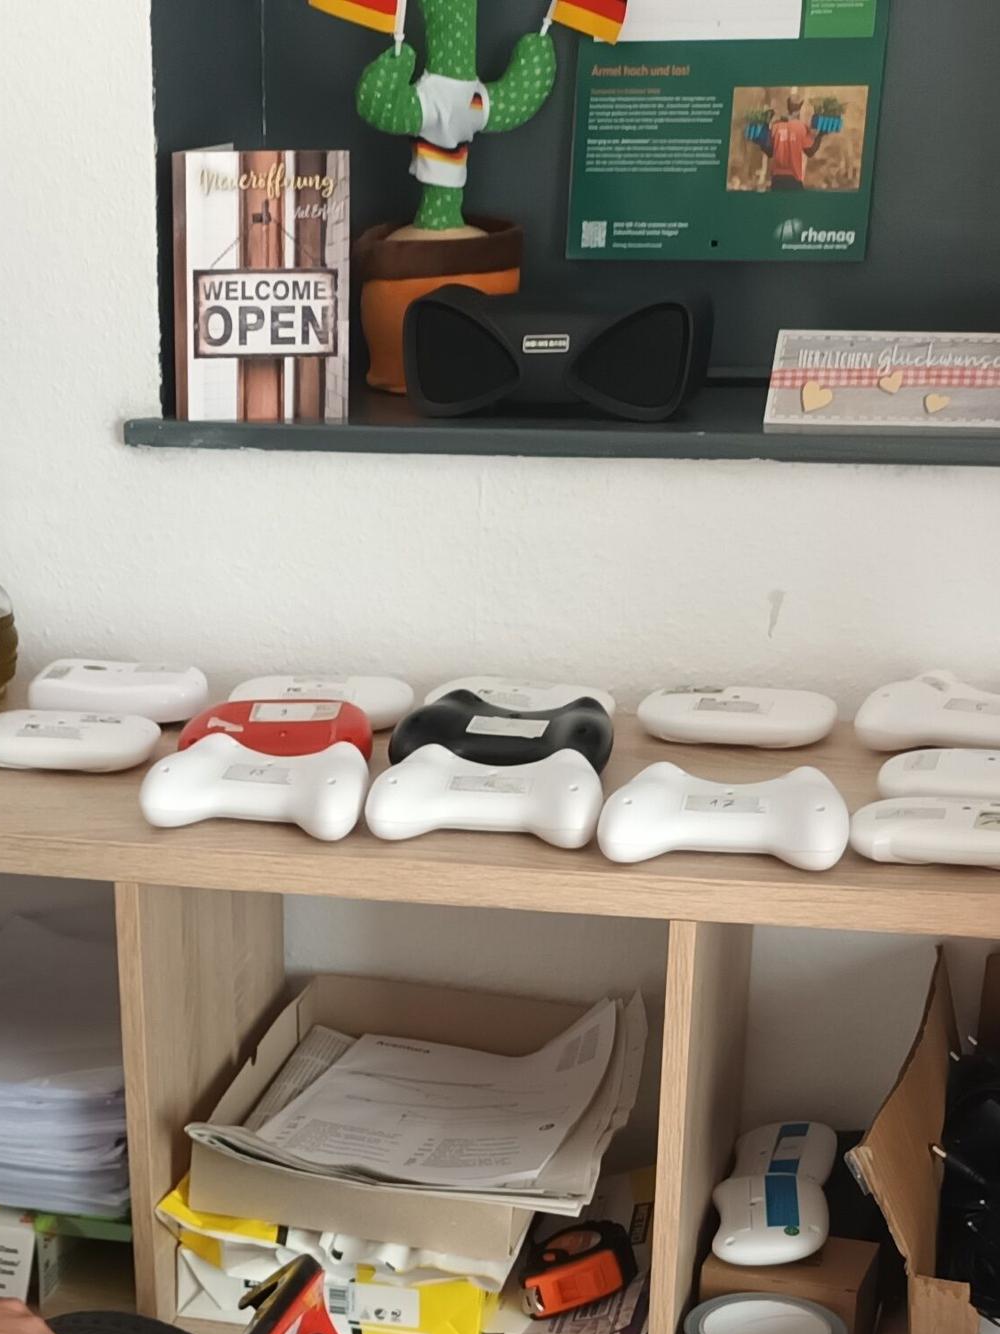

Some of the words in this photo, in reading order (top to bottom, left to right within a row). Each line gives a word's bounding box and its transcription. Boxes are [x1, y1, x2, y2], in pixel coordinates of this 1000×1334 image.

[801, 227, 856, 245] rhenag
[203, 280, 328, 301] WELCOME
[203, 305, 330, 347] OPEN
[798, 348, 874, 369] HERZLICHEN
